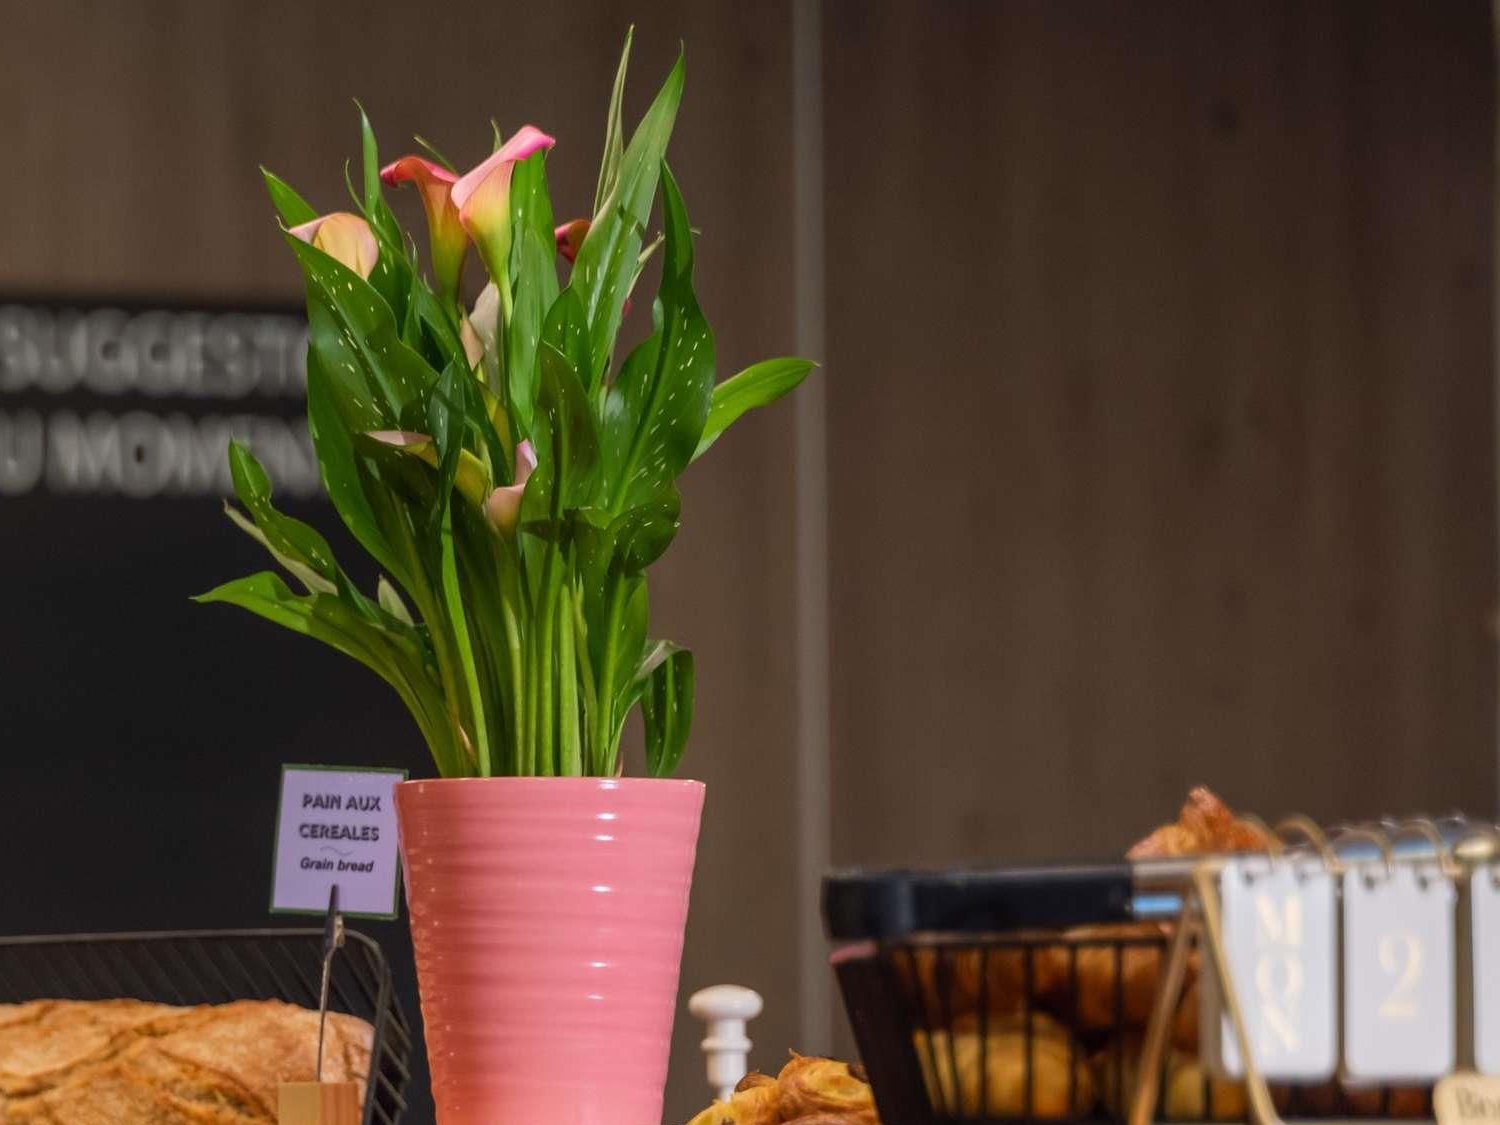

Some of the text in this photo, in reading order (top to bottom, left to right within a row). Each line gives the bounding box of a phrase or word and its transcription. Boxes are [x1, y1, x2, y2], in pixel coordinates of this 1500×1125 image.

[303, 794, 381, 811] PAIN AUX
[299, 823, 380, 841] CEREALES
[300, 857, 374, 872] Grain bread
[1378, 932, 1423, 1018] 2
